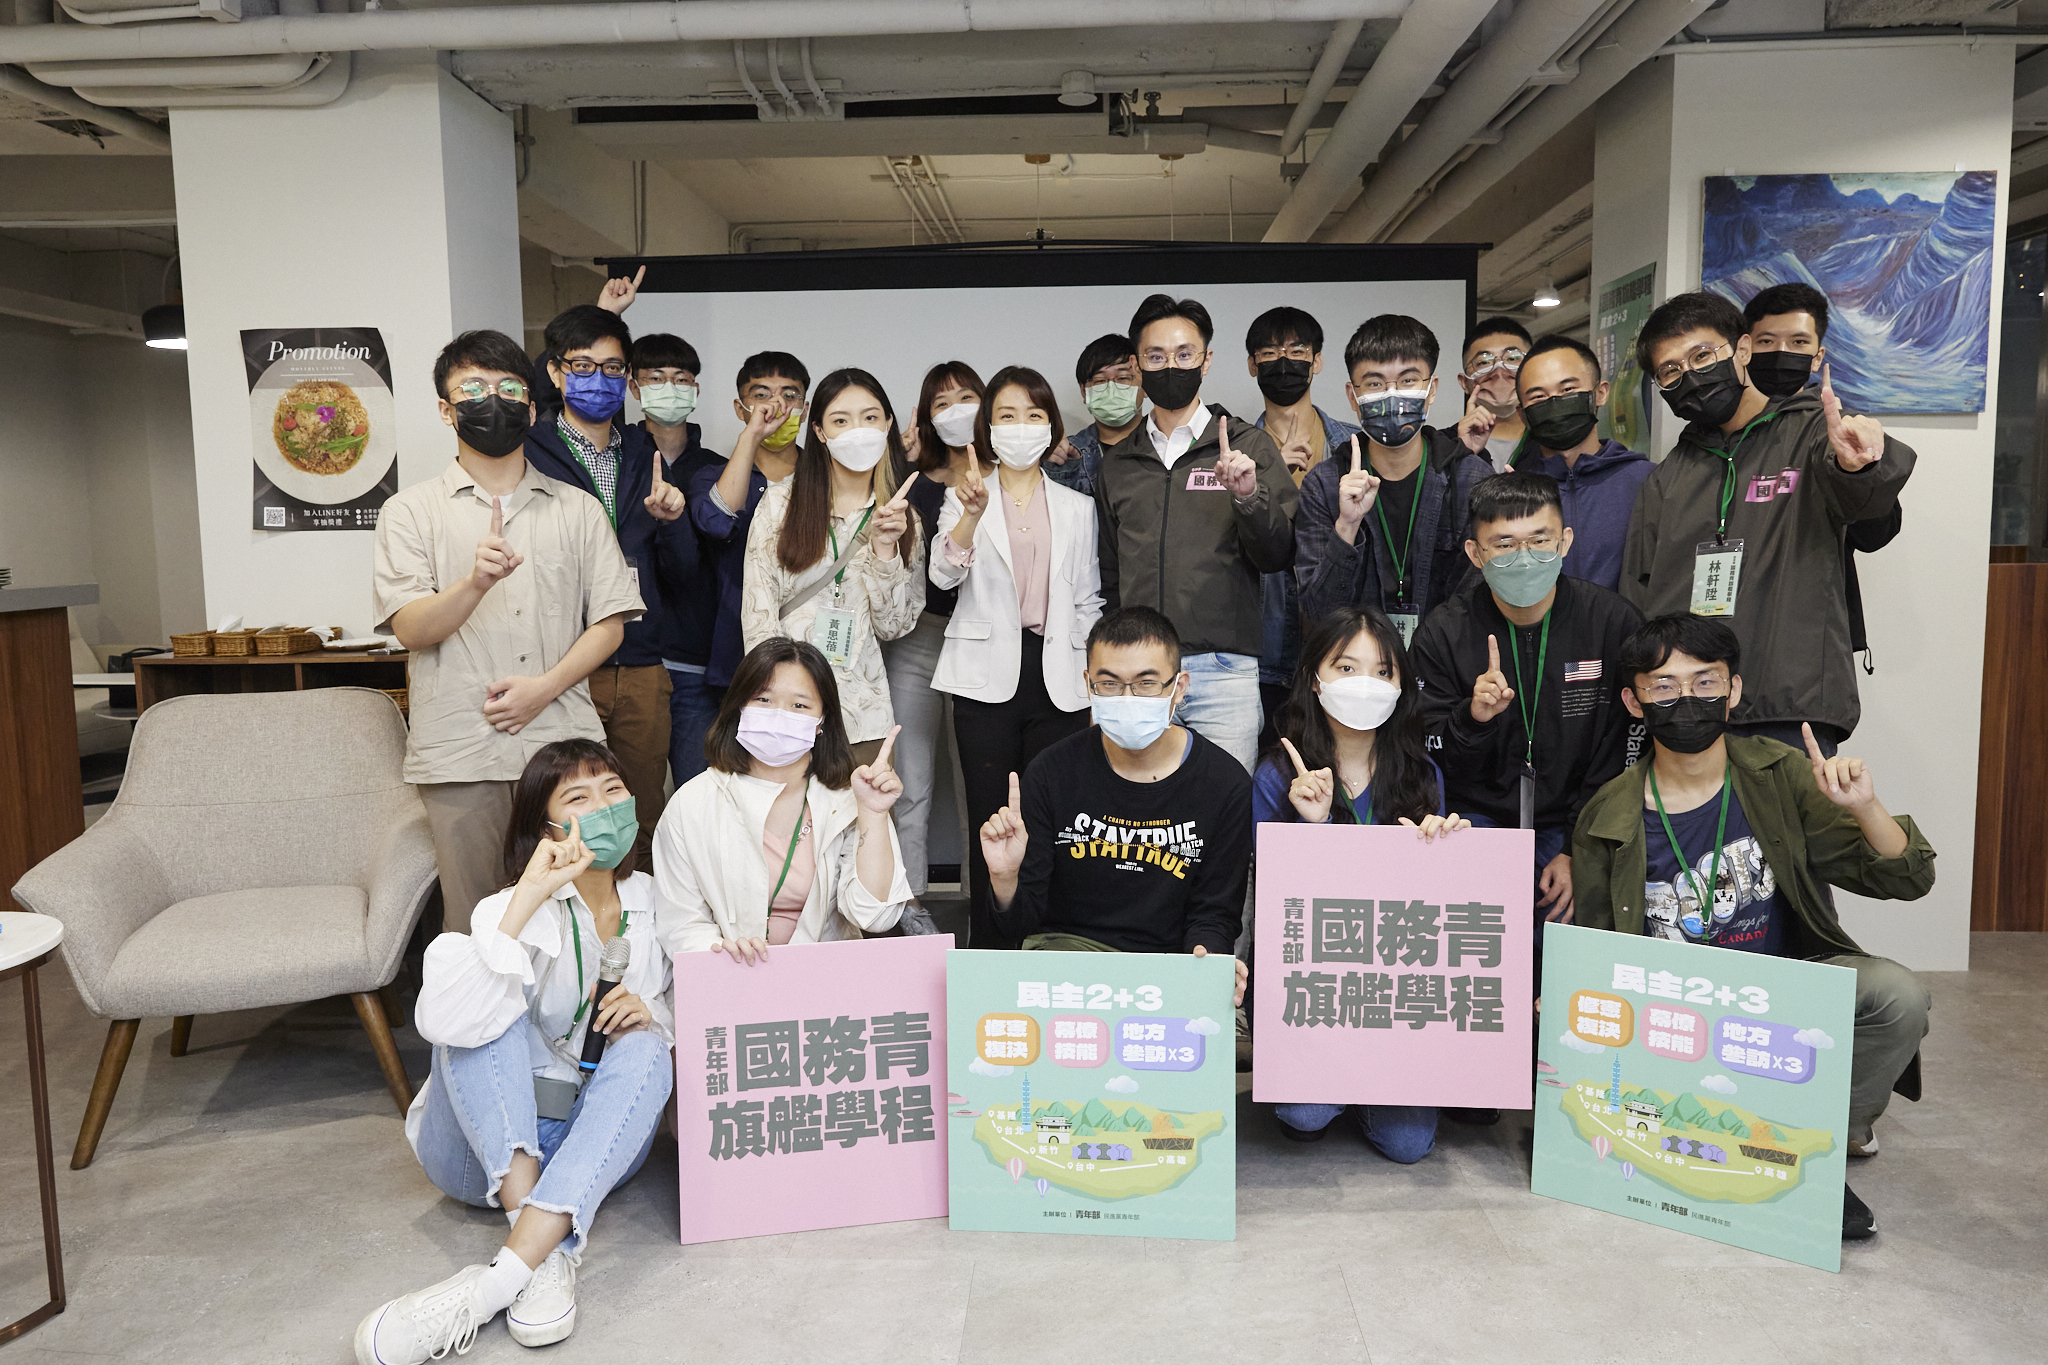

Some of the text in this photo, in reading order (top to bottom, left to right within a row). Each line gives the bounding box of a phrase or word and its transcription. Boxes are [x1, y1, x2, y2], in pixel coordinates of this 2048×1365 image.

[267, 341, 371, 361] Promotion
[1194, 475, 1224, 487] 國務
[303, 508, 351, 517] 加入LINE好友
[1705, 560, 1721, 601] 林軒陞
[826, 619, 840, 652] 黃思蓓
[1625, 723, 1646, 770] State
[1283, 898, 1305, 964] 青年部
[1312, 898, 1506, 968] 國務青
[1016, 981, 1163, 1011] 民主2+3
[1612, 963, 1770, 1014] 民主2+3
[1282, 971, 1505, 1032] 旗艦學程
[1122, 1022, 1166, 1042] 地方
[1722, 1022, 1772, 1046] 地方
[705, 1027, 729, 1096] 青年部
[735, 1011, 931, 1092] 國務青
[997, 1110, 1017, 1121] 基隆
[1592, 1104, 1612, 1116] 台北
[708, 1085, 935, 1161] 旗艦學程
[1004, 1126, 1024, 1136] 台北
[1626, 1130, 1647, 1142] 新竹
[1038, 1145, 1058, 1155] 新竹
[1166, 1155, 1186, 1165] 高雄
[1664, 1154, 1685, 1166] 台中
[1075, 1162, 1095, 1172] 台中
[1764, 1167, 1787, 1180] 高雄
[1075, 1210, 1101, 1220] 青年部
[1661, 1202, 1688, 1216] 青年部
